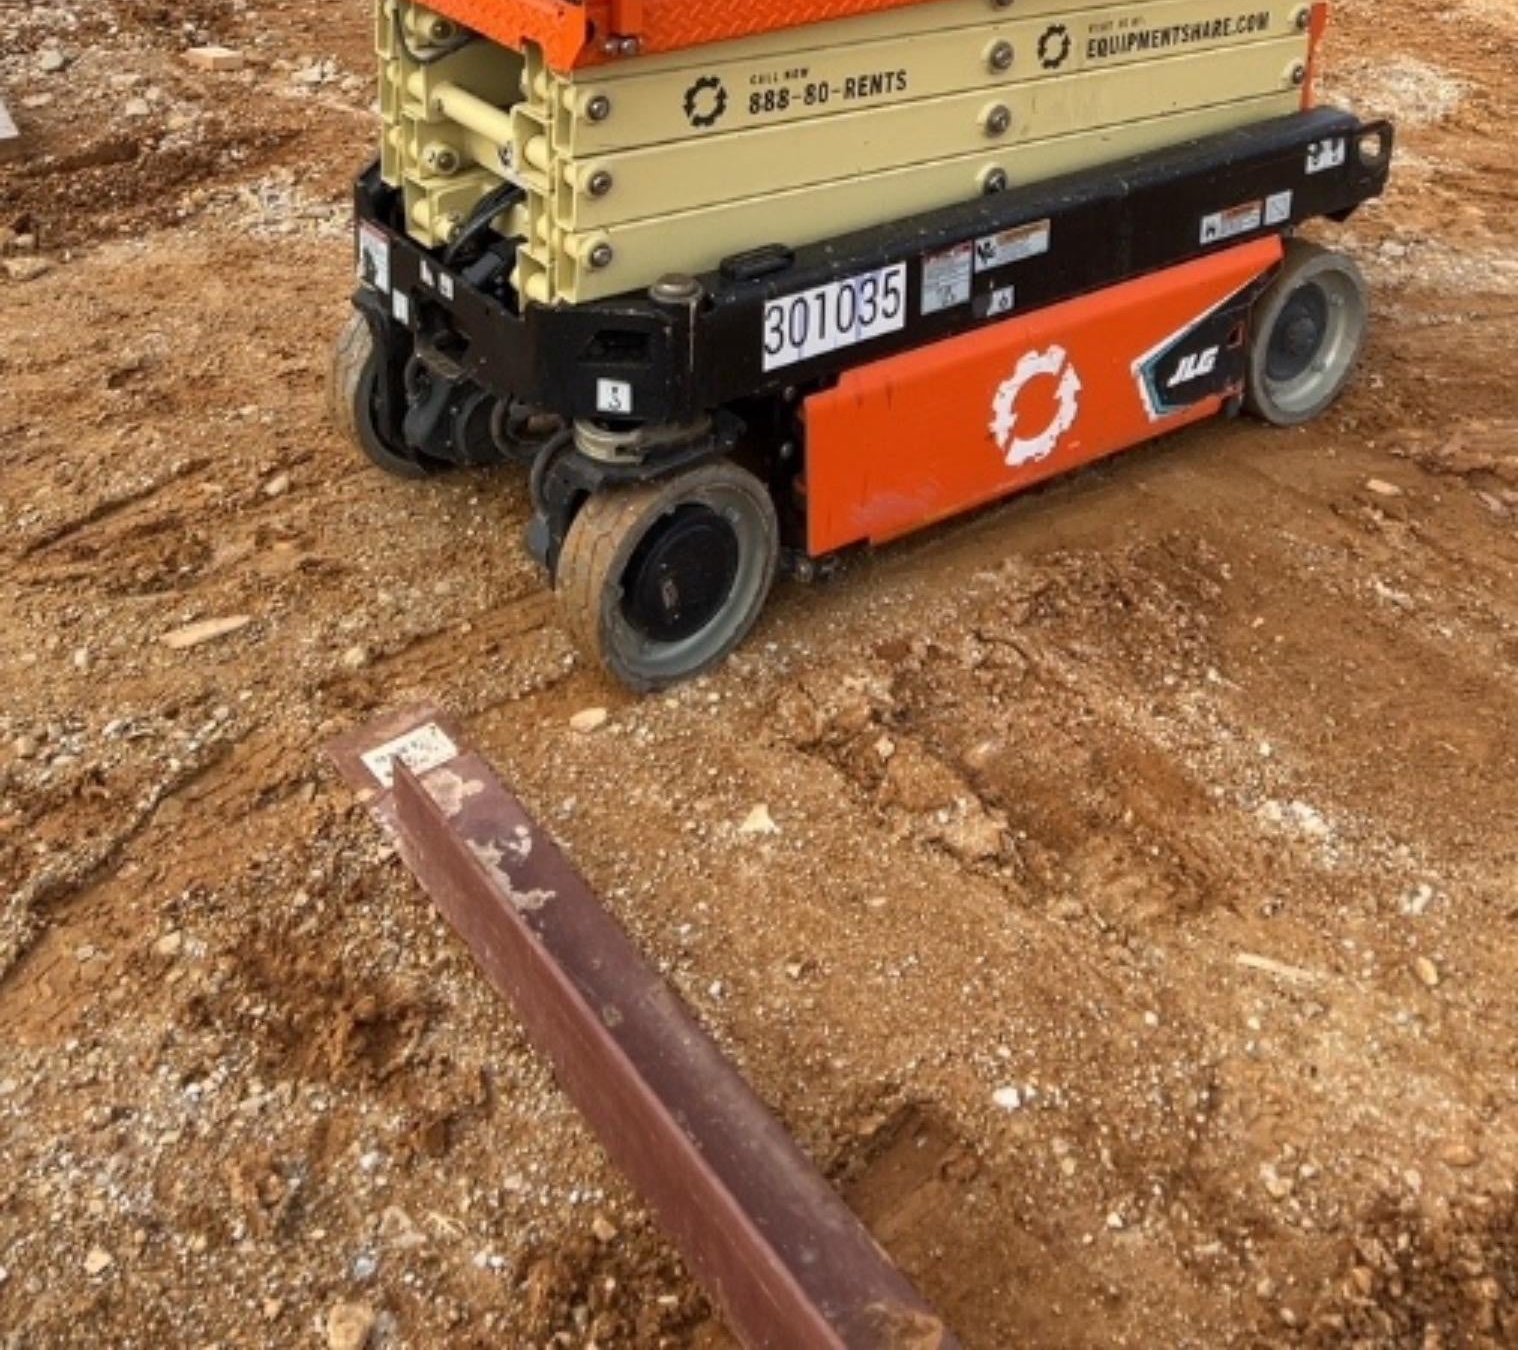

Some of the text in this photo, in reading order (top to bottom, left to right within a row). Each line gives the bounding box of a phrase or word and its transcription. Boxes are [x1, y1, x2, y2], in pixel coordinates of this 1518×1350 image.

[1086, 11, 1270, 59] EQUIPMENTSHARE.COM
[748, 68, 907, 115] 888-80-RENTS
[764, 269, 901, 355] 301035
[1166, 345, 1219, 388] JLG
